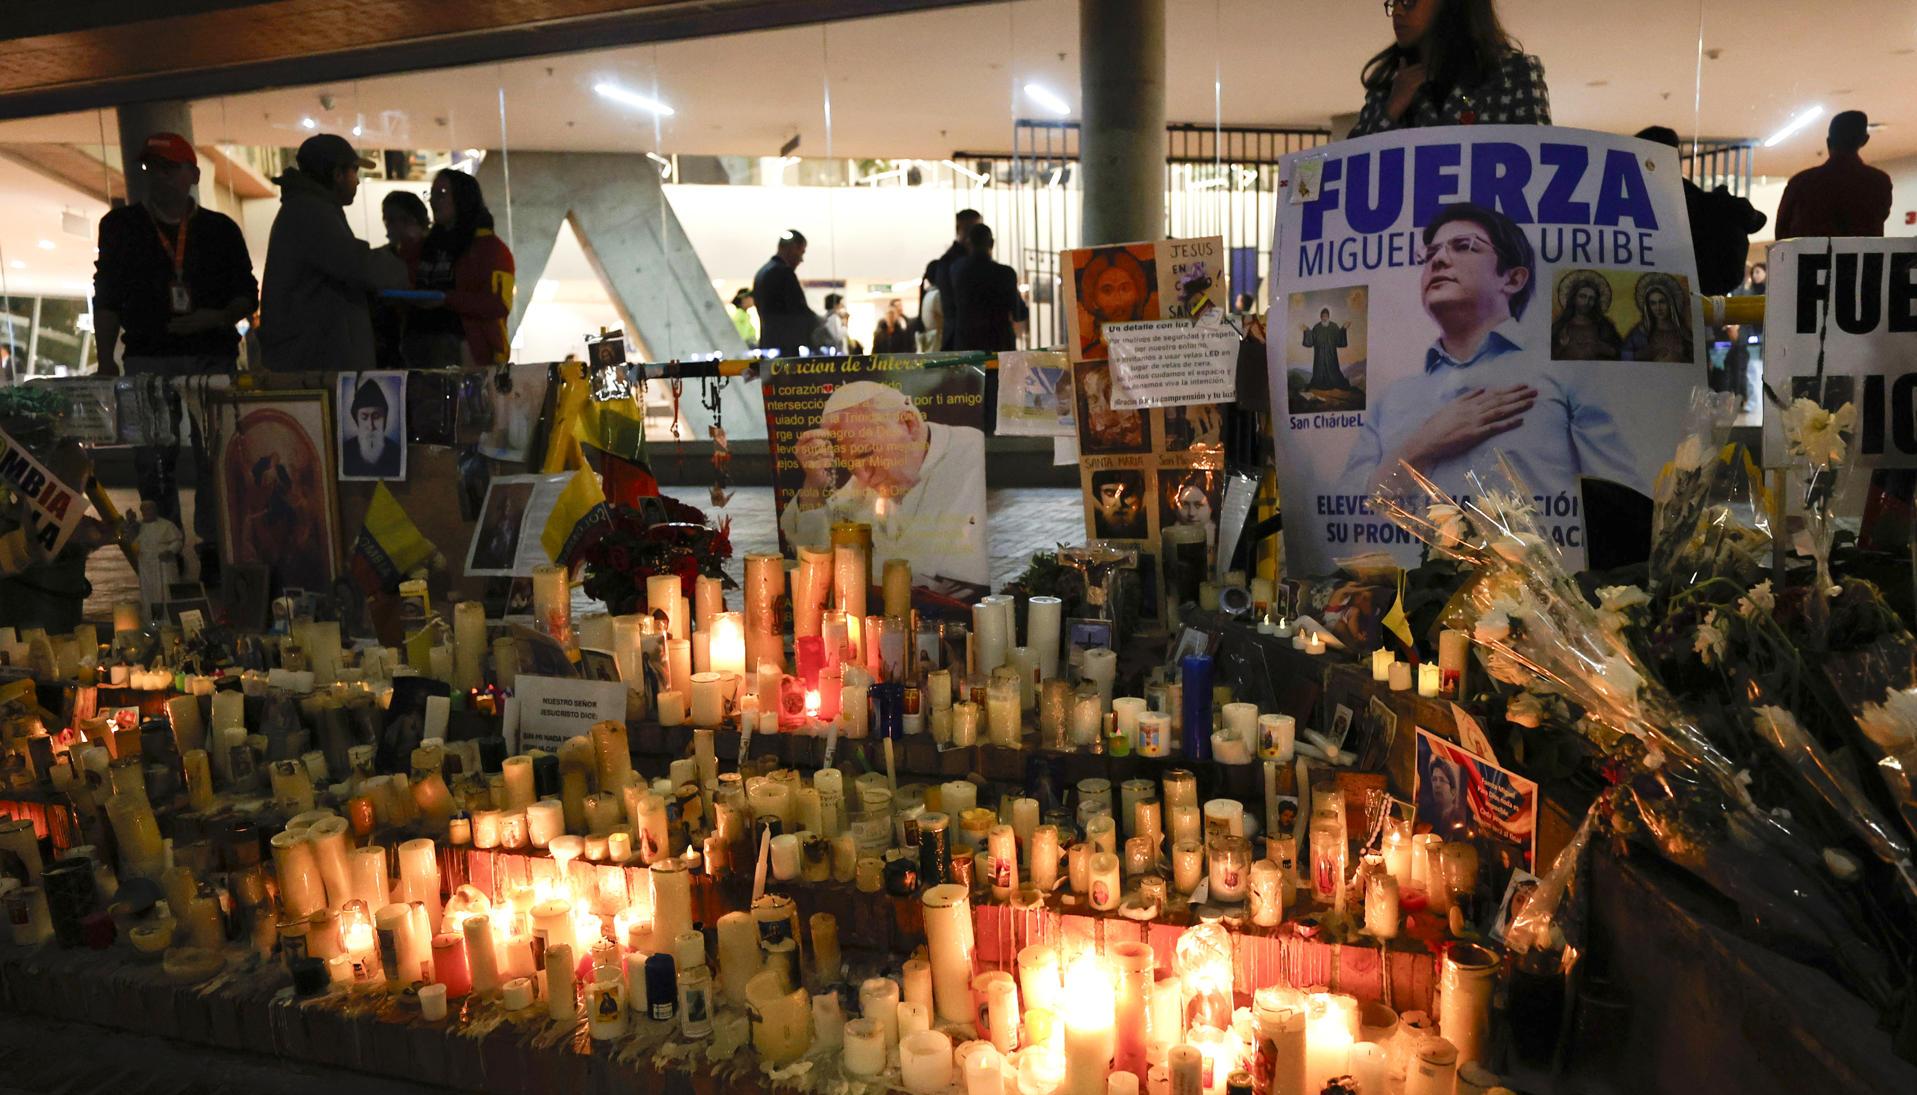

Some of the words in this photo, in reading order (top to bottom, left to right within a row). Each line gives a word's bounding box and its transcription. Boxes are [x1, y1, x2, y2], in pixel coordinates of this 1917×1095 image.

[1301, 142, 1658, 243] FUERZA
[1170, 242, 1214, 258] JESUS
[1299, 231, 1418, 278] MIGUEL
[1541, 227, 1656, 266] URIBE
[1172, 264, 1186, 274] EN
[1123, 323, 1154, 332] detalle
[1148, 344, 1176, 352] nuestro
[1204, 350, 1220, 358] LED
[841, 356, 862, 372] de
[1131, 364, 1149, 372] lugar
[1161, 361, 1181, 369] velas
[1151, 370, 1186, 379] cuidamos
[778, 383, 823, 396] corazón
[936, 393, 944, 405] ti
[947, 393, 983, 406] amigo
[1160, 392, 1206, 403] comprensión
[1207, 393, 1212, 401] y
[1289, 416, 1310, 430] San
[1084, 455, 1113, 470] SANTA
[1326, 522, 1348, 544] SU
[1354, 523, 1422, 544] PRON
[542, 698, 573, 706] NUESTRO
[574, 699, 598, 708] SEÑOR
[541, 709, 579, 718] JESUCRISTO
